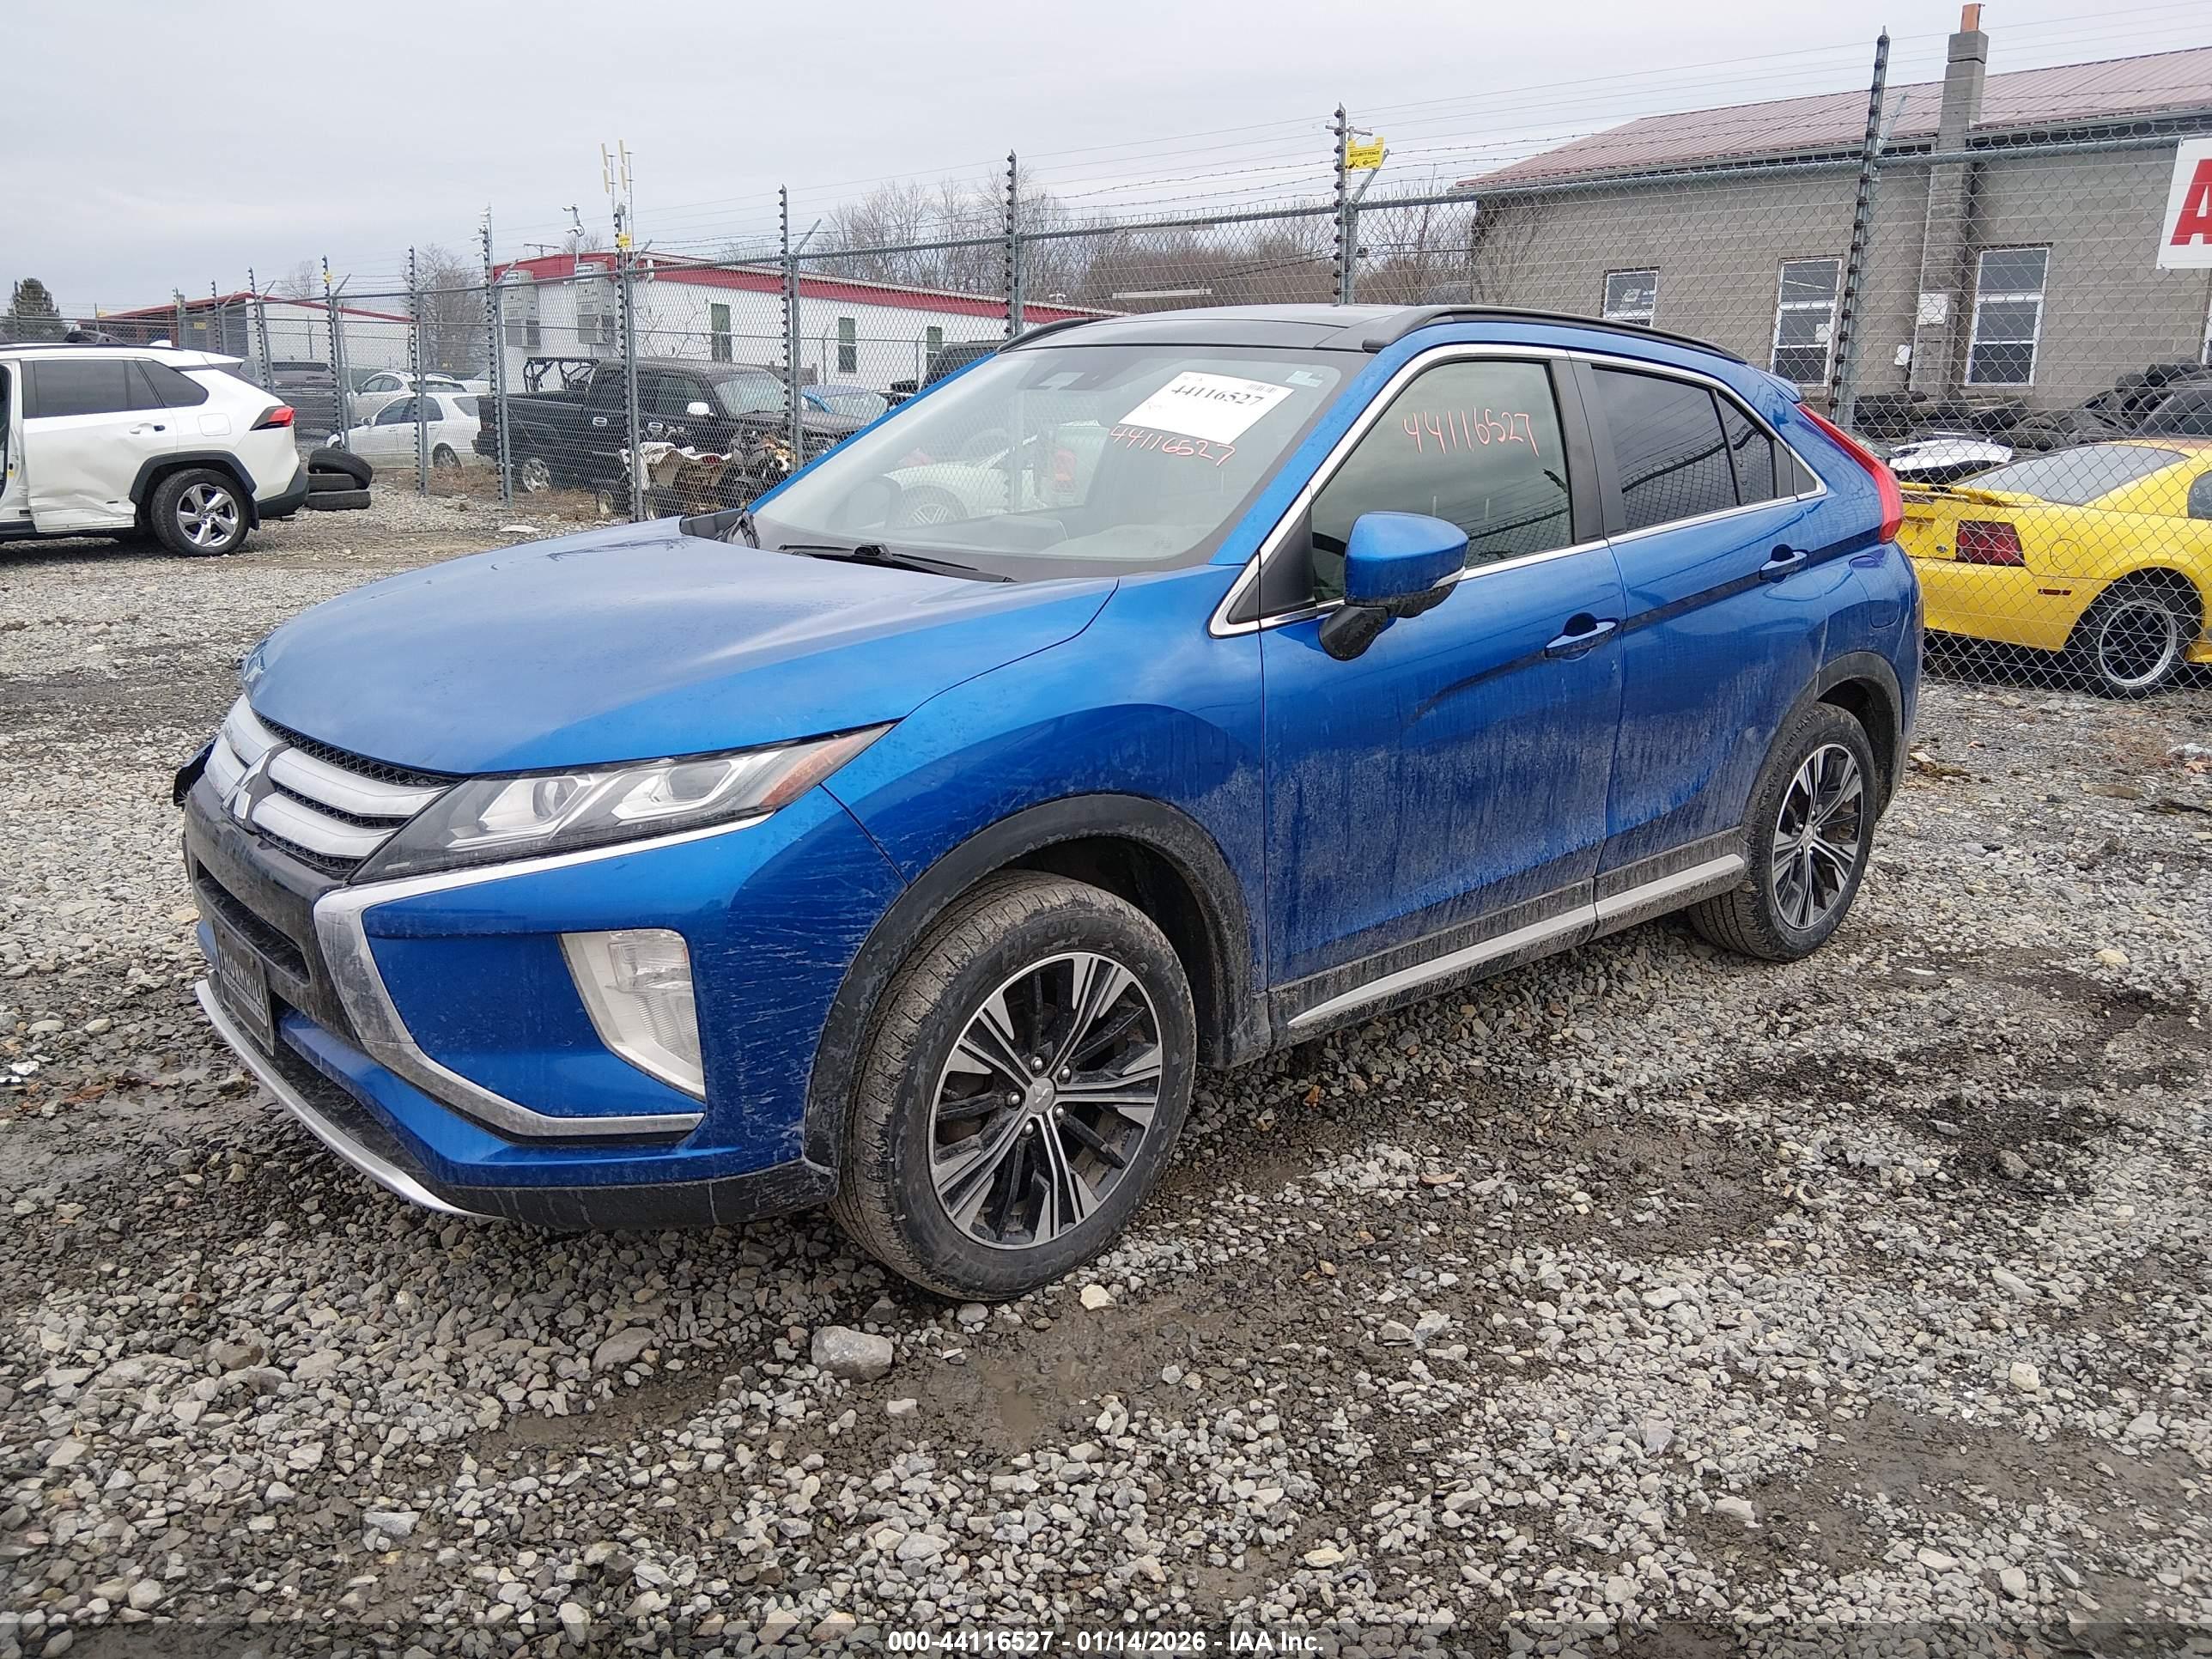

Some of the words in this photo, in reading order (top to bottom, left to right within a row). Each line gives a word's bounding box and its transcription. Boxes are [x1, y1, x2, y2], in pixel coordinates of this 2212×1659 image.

[1171, 385, 1264, 406] 44116527
[1110, 425, 1236, 468] 44116527
[1403, 405, 1540, 458] 44116527
